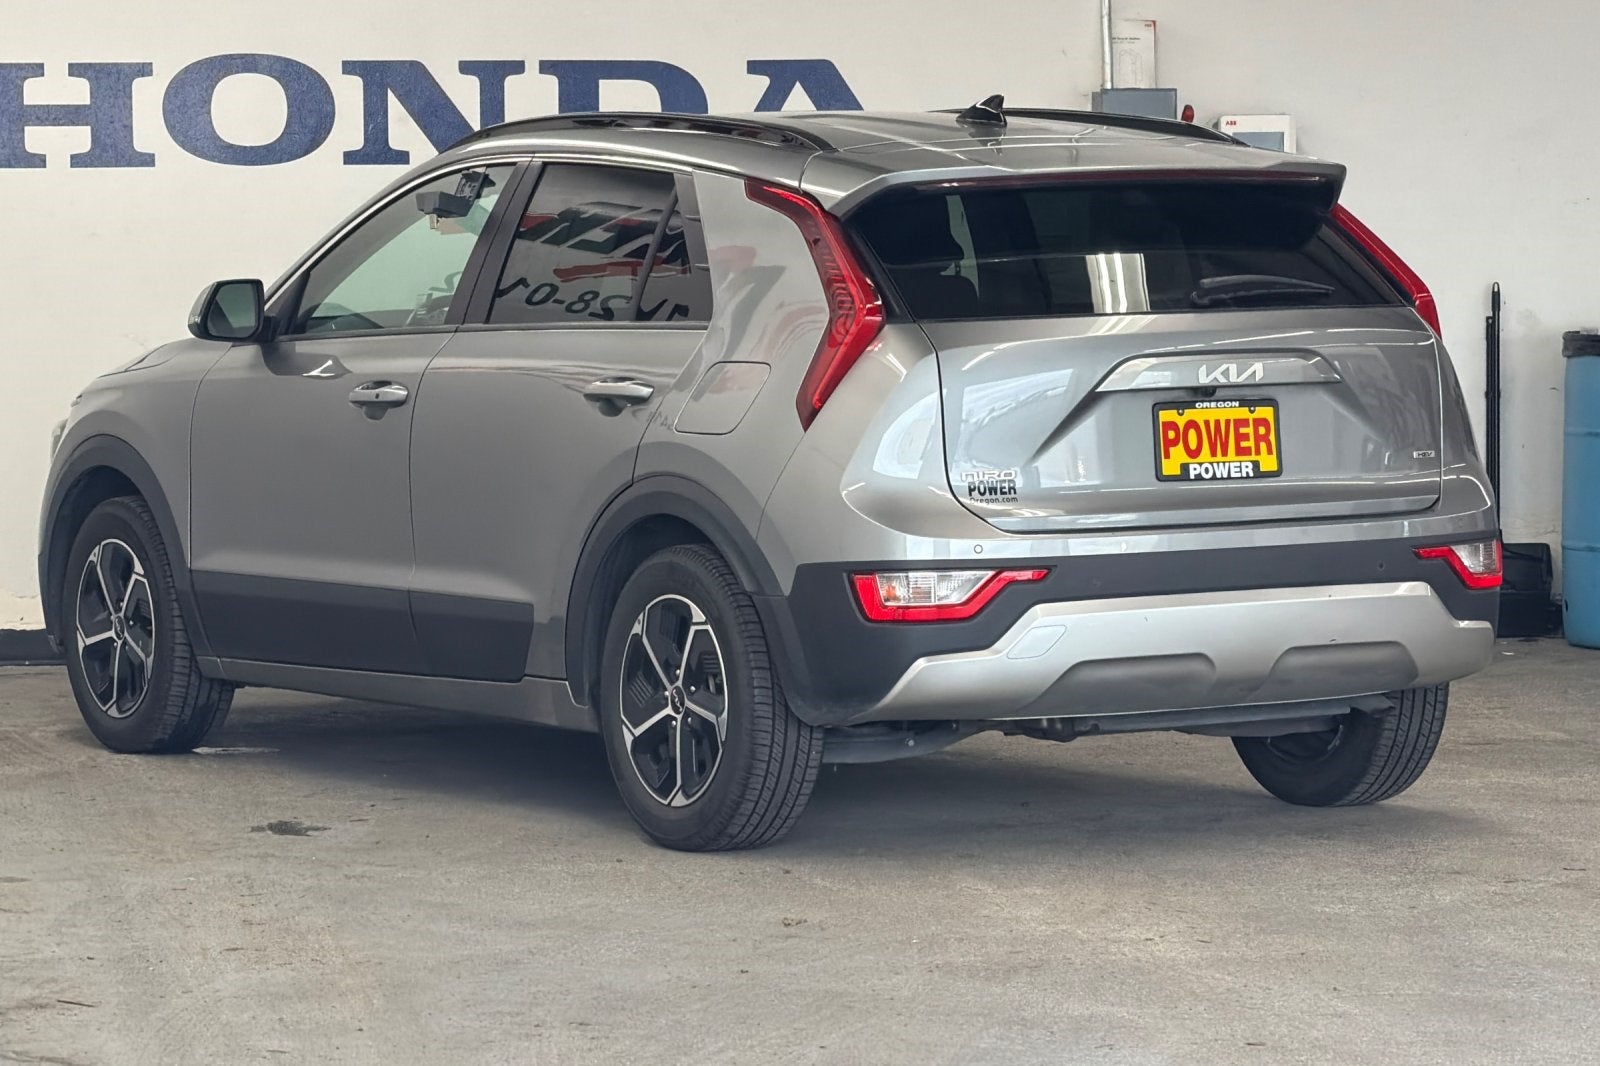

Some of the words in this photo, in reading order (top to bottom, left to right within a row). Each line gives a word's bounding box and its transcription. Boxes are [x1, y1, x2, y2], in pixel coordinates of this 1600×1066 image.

[1198, 362, 1264, 384] KIA
[1195, 401, 1240, 409] OREGON
[1161, 417, 1274, 460] POWER
[1188, 461, 1254, 479] POWER
[968, 480, 1017, 496] POWER
